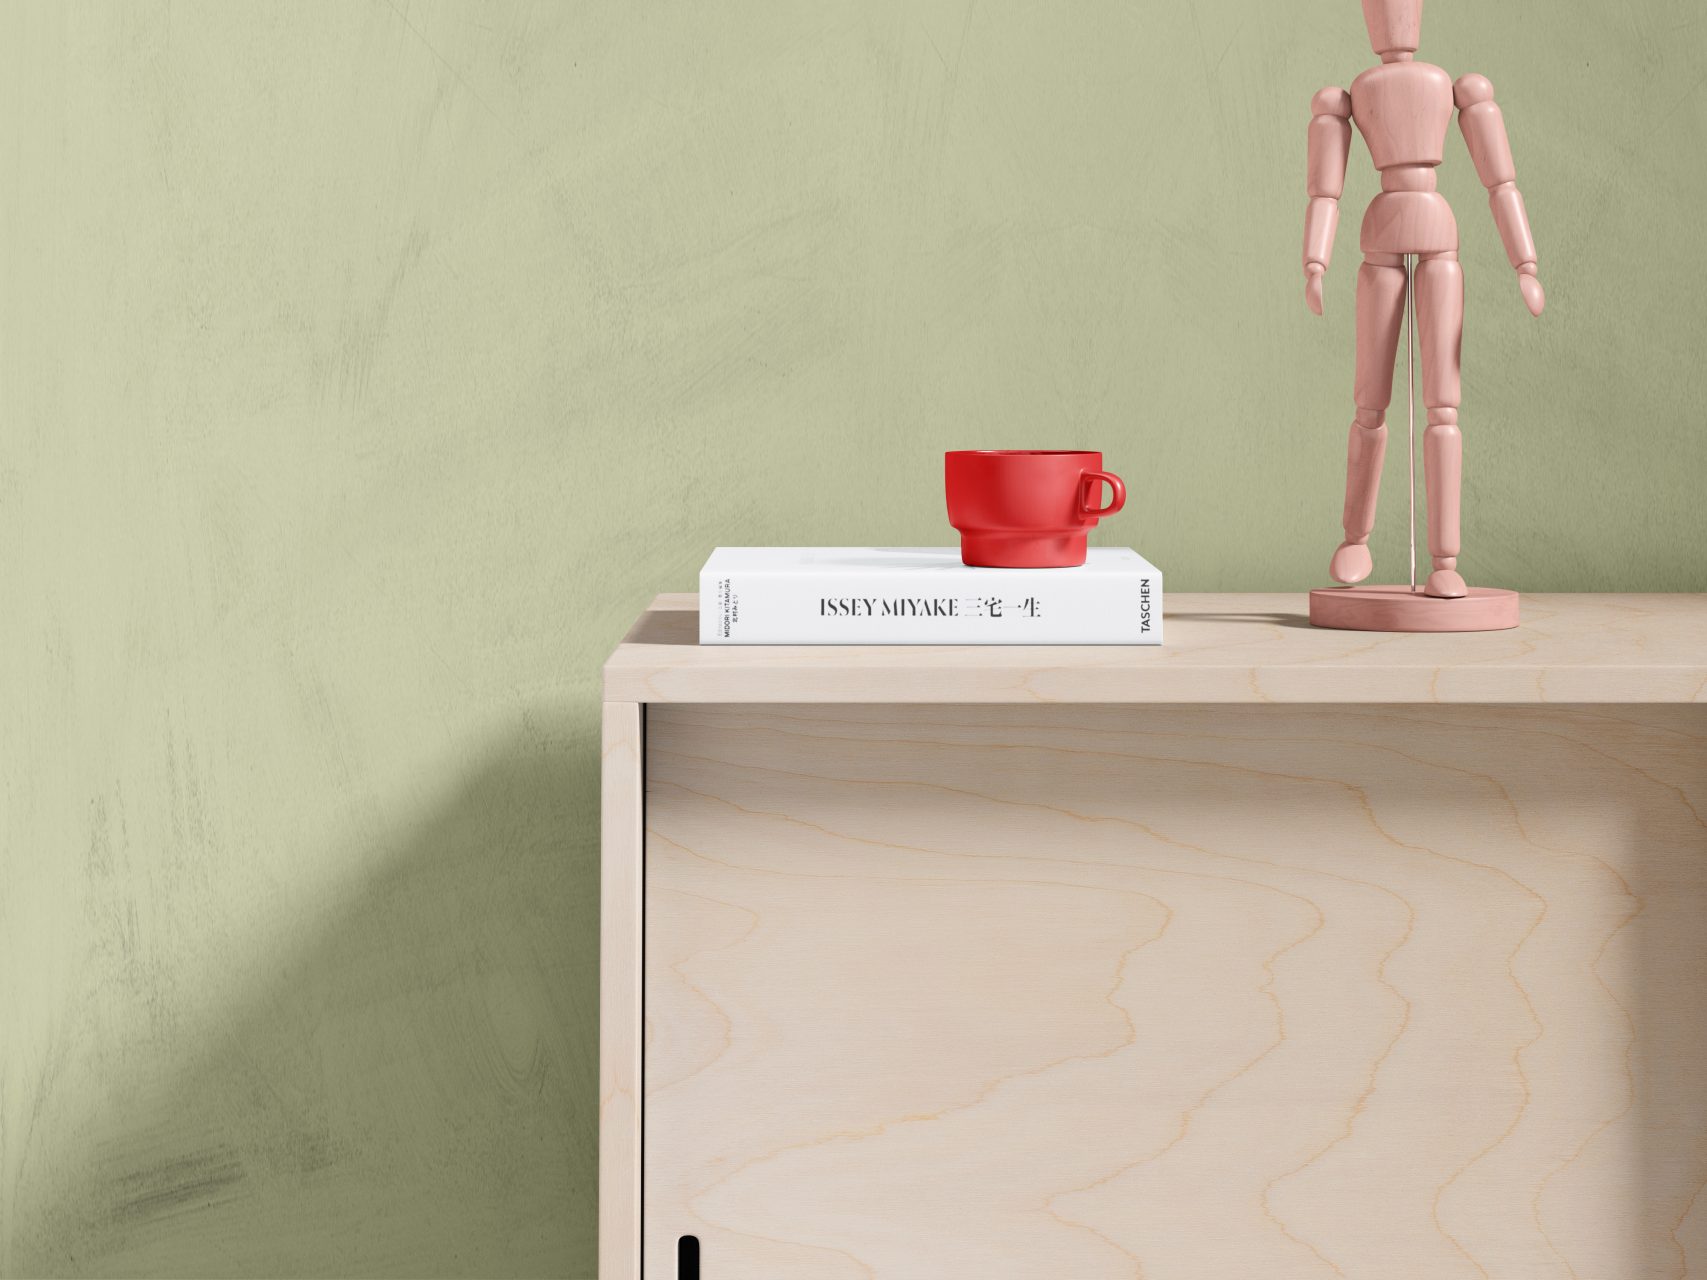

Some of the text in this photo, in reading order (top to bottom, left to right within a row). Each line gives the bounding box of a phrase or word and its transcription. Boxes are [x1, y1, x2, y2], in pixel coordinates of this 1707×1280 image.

[820, 596, 1042, 618] ISSEY MIYAKE 三宅一生
[1140, 579, 1151, 634] TASCHEN
